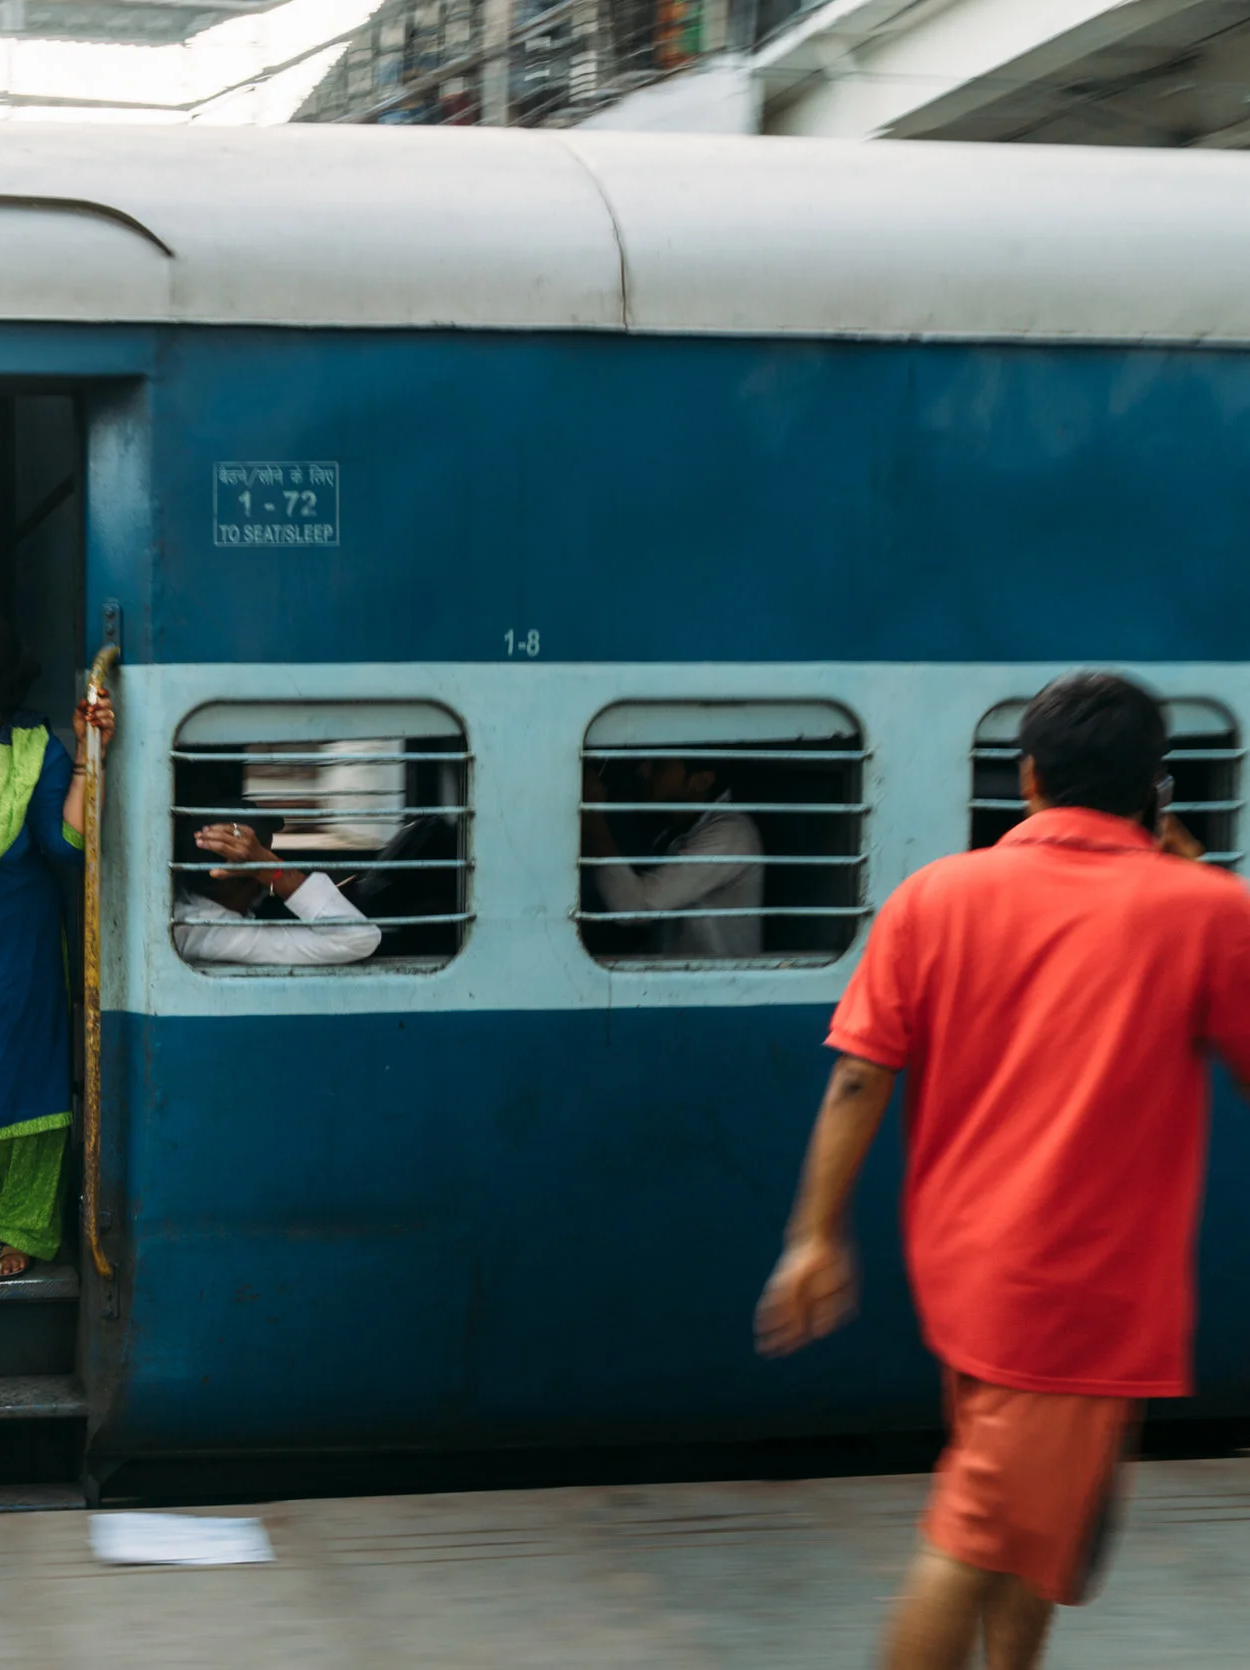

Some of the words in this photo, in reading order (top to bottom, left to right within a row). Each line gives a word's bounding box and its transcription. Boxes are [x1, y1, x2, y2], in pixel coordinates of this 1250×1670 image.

[290, 464, 303, 485] के
[309, 464, 334, 487] लिए
[218, 523, 240, 543] TO
[503, 627, 540, 657] 1-8
